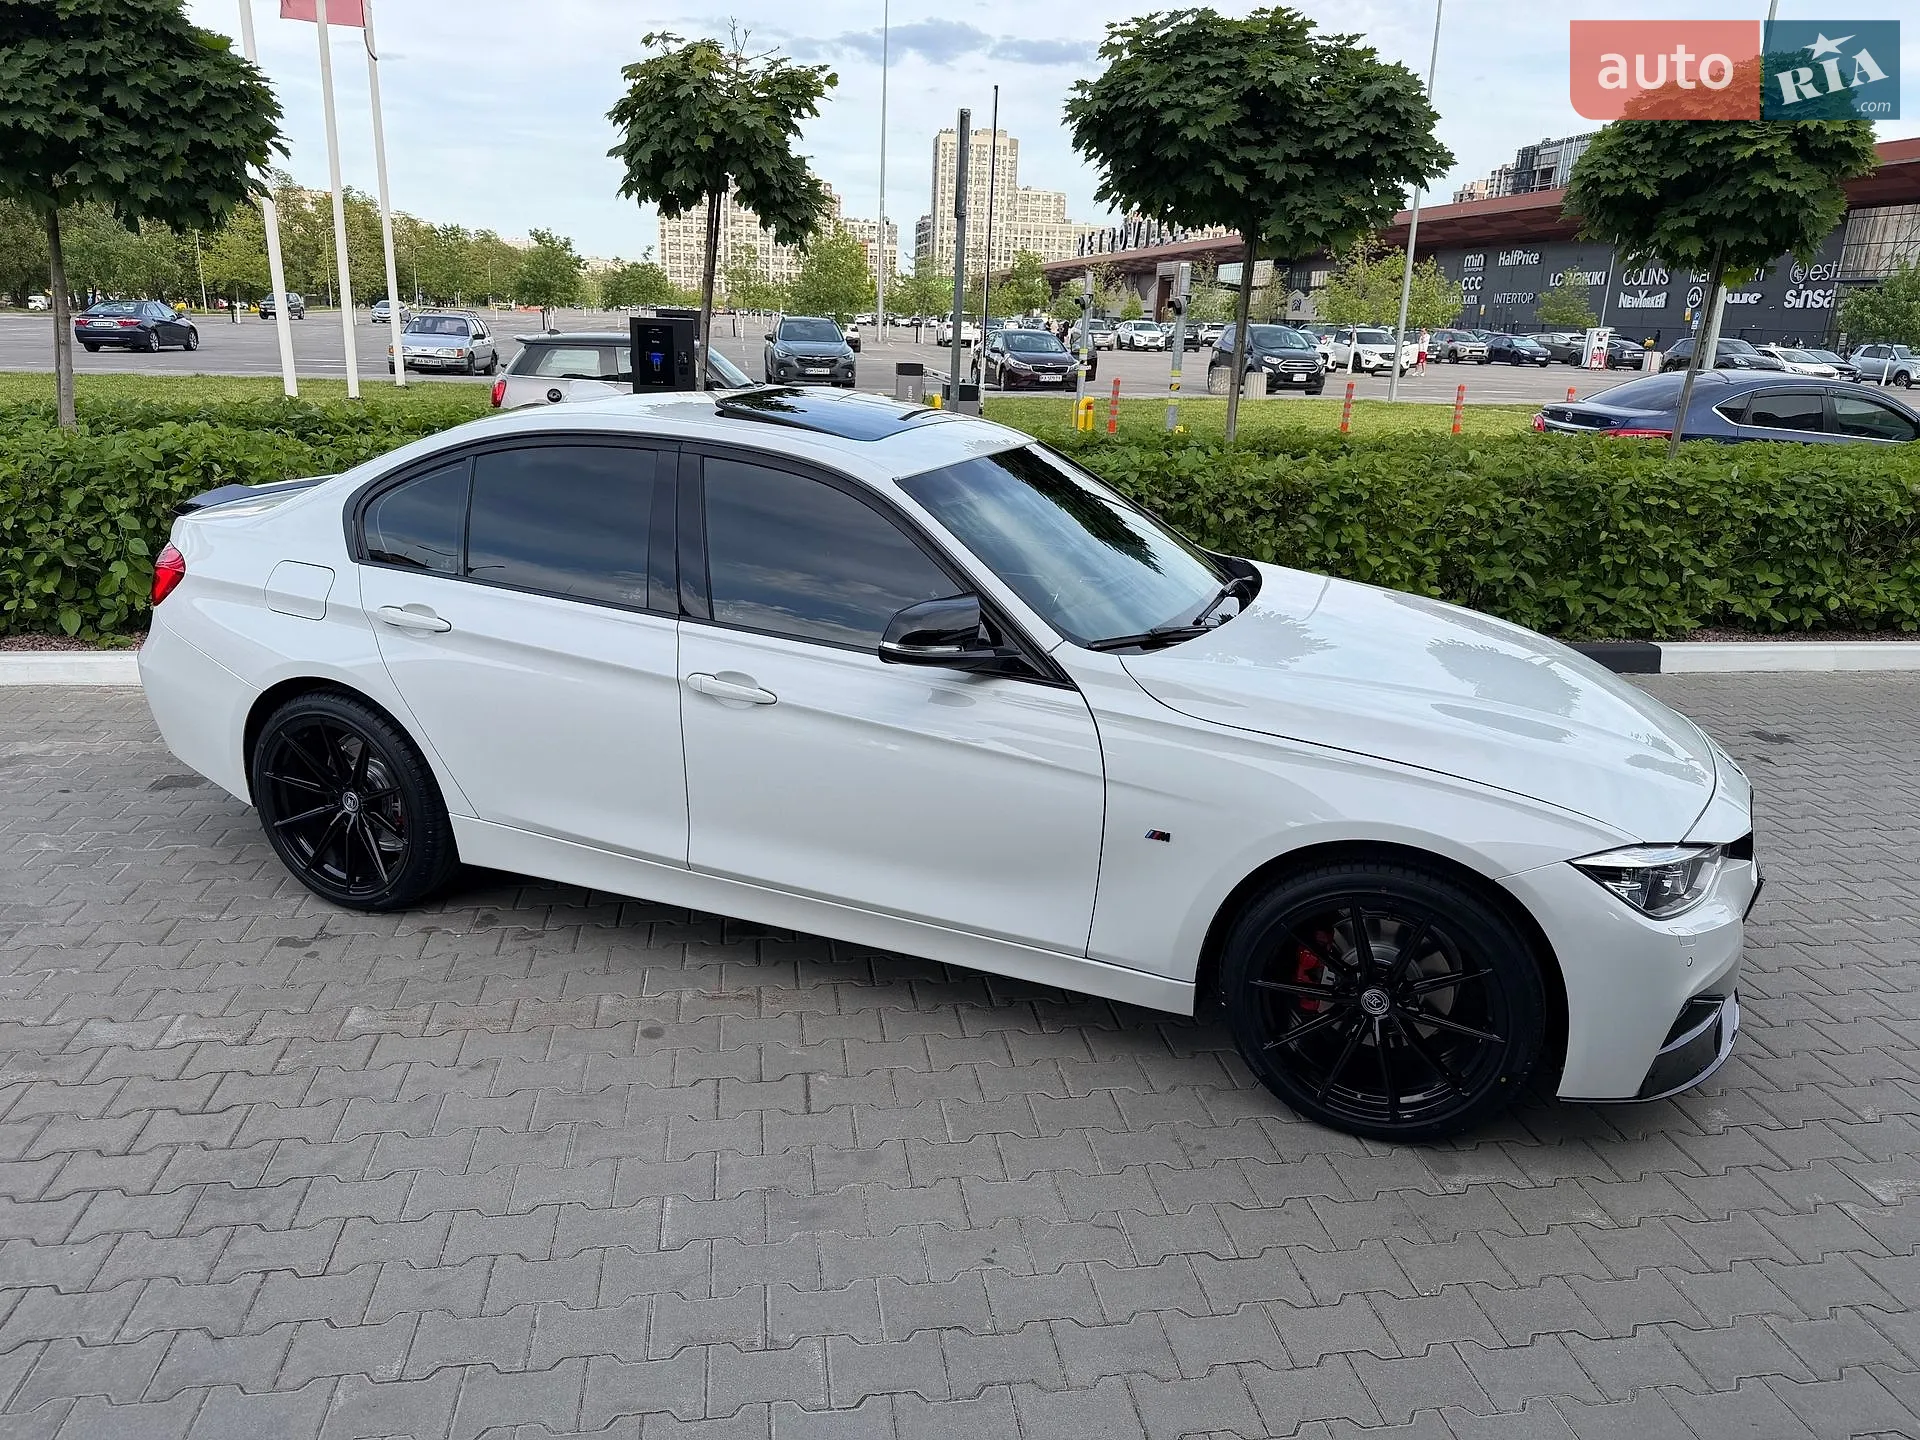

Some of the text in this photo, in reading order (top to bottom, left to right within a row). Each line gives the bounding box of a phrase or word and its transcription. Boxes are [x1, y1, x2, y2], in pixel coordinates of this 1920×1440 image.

[1498, 249, 1540, 266] HalfPrice
[1461, 276, 1483, 290] CCC
[1549, 272, 1564, 287] LC
[1622, 267, 1670, 286] COLIN'S
[1493, 292, 1534, 304] INTERTOP
